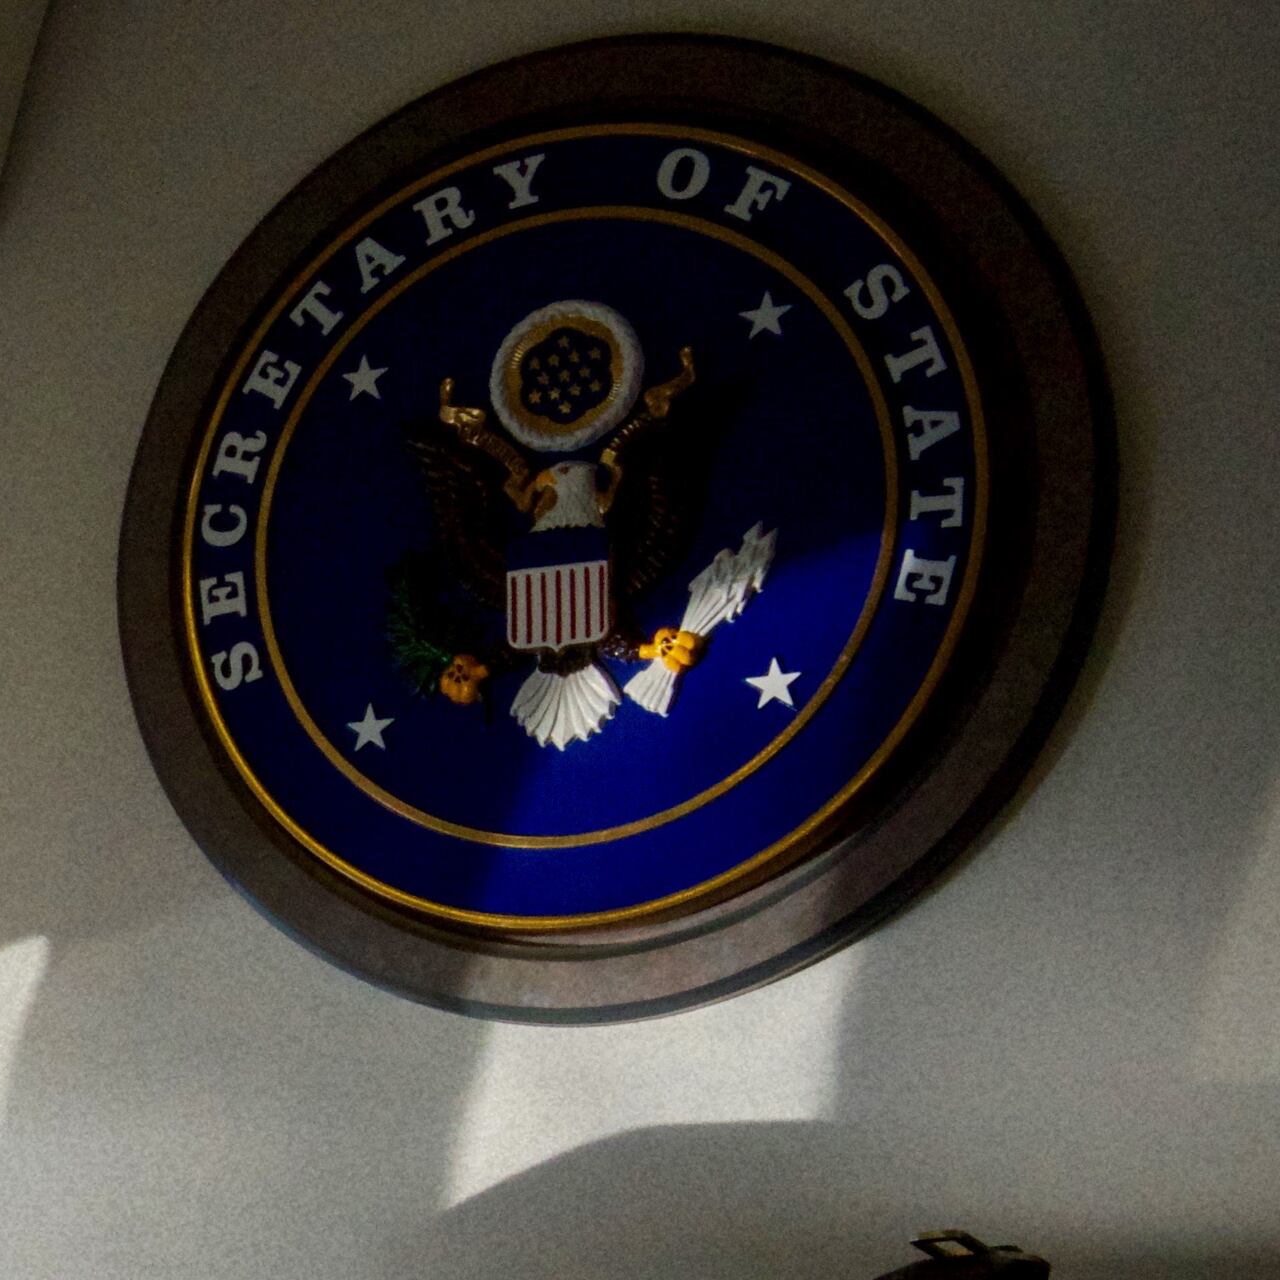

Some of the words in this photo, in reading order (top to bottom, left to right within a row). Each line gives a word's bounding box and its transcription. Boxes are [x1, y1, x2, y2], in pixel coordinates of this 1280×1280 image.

[199, 153, 548, 693] SECRETARY
[655, 146, 792, 227] OF
[842, 262, 967, 610] STATE
